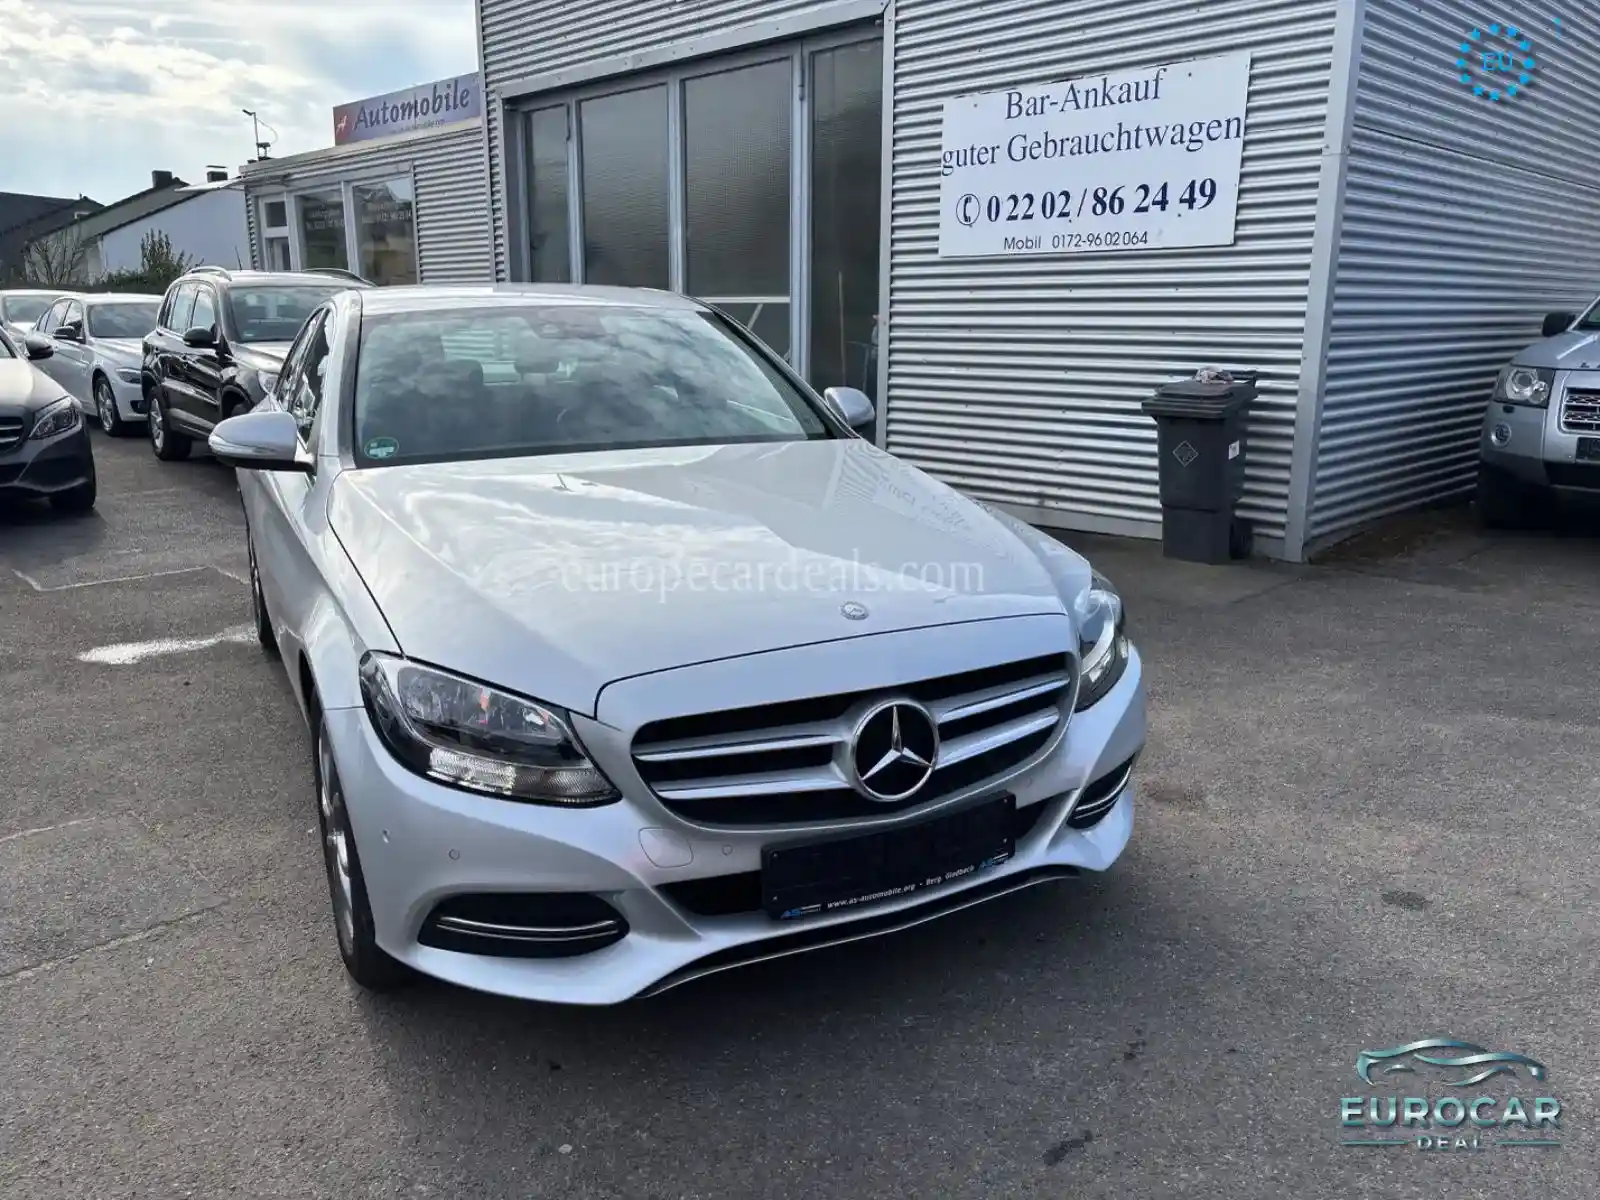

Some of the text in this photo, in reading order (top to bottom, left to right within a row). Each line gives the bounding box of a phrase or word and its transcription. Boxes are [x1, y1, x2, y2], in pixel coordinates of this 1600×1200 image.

[353, 79, 470, 131] Automobile
[1005, 67, 1168, 120] Bar-Ankauf
[941, 114, 1242, 176] guter Gebrauchtwagen
[1003, 235, 1042, 250] Mobil
